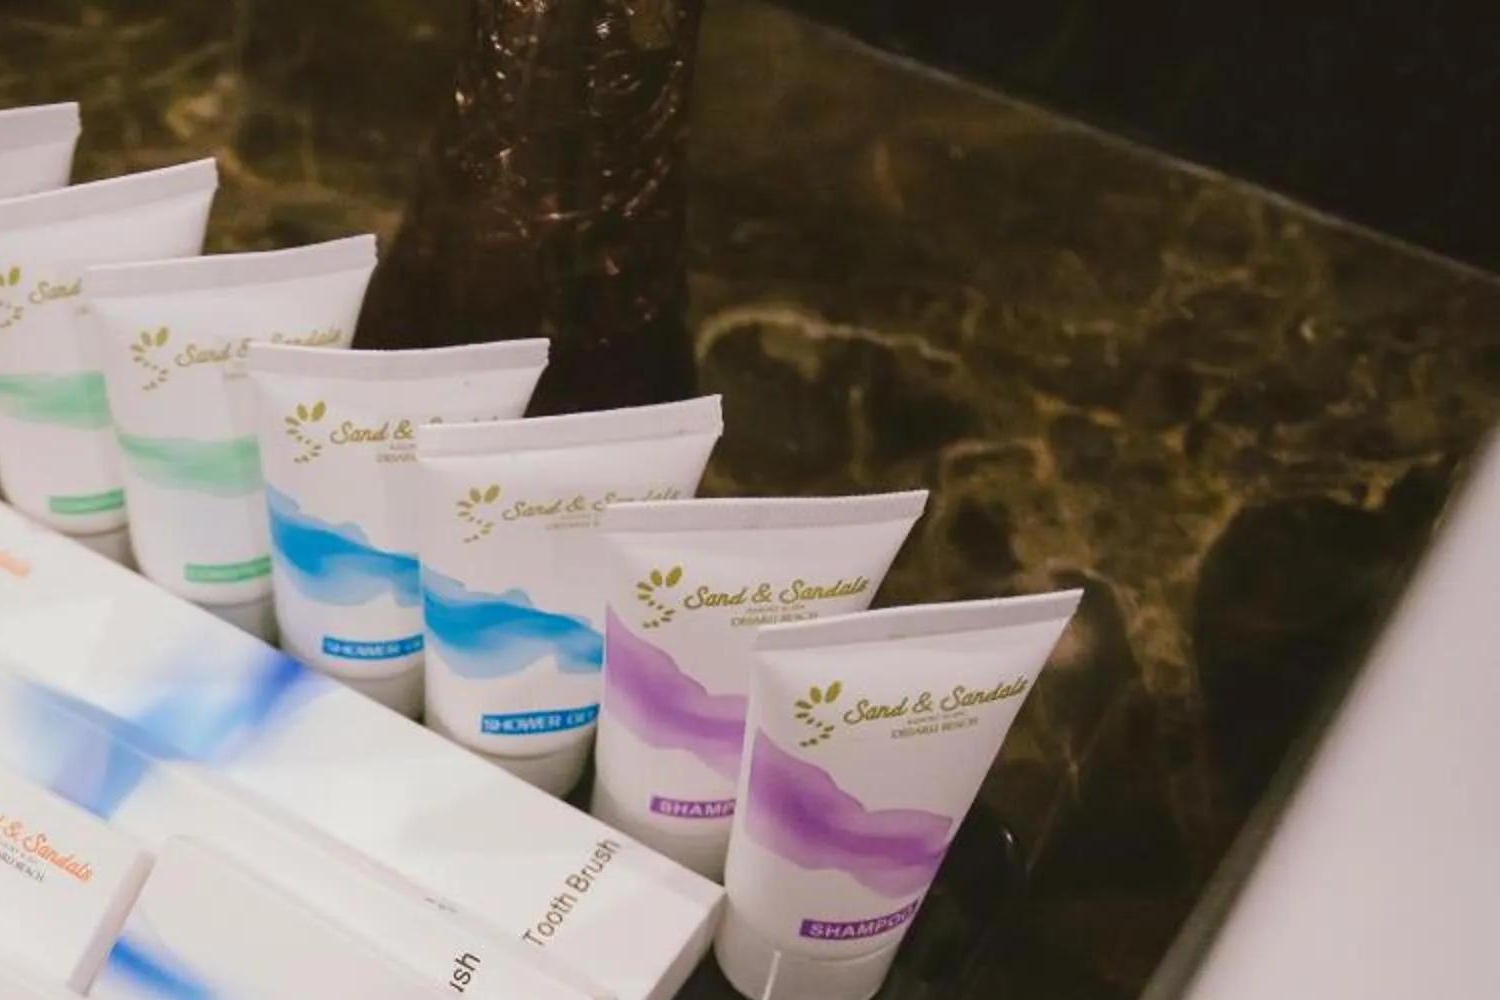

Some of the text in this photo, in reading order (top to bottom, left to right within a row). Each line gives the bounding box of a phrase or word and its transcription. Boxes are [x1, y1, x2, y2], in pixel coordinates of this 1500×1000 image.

[28, 278, 82, 305] Sand
[174, 342, 231, 367] Sand
[330, 420, 414, 445] Sand &
[502, 500, 562, 521] Sand
[566, 495, 586, 512] &
[683, 576, 869, 610] Sand & Sandals
[843, 699, 909, 724] Sand
[912, 692, 933, 713] &
[940, 674, 1029, 711] Sandals
[660, 801, 735, 817] SHAMP
[2, 820, 23, 838] &
[22, 832, 94, 885] Sandals
[522, 838, 621, 947] Tooth Brush
